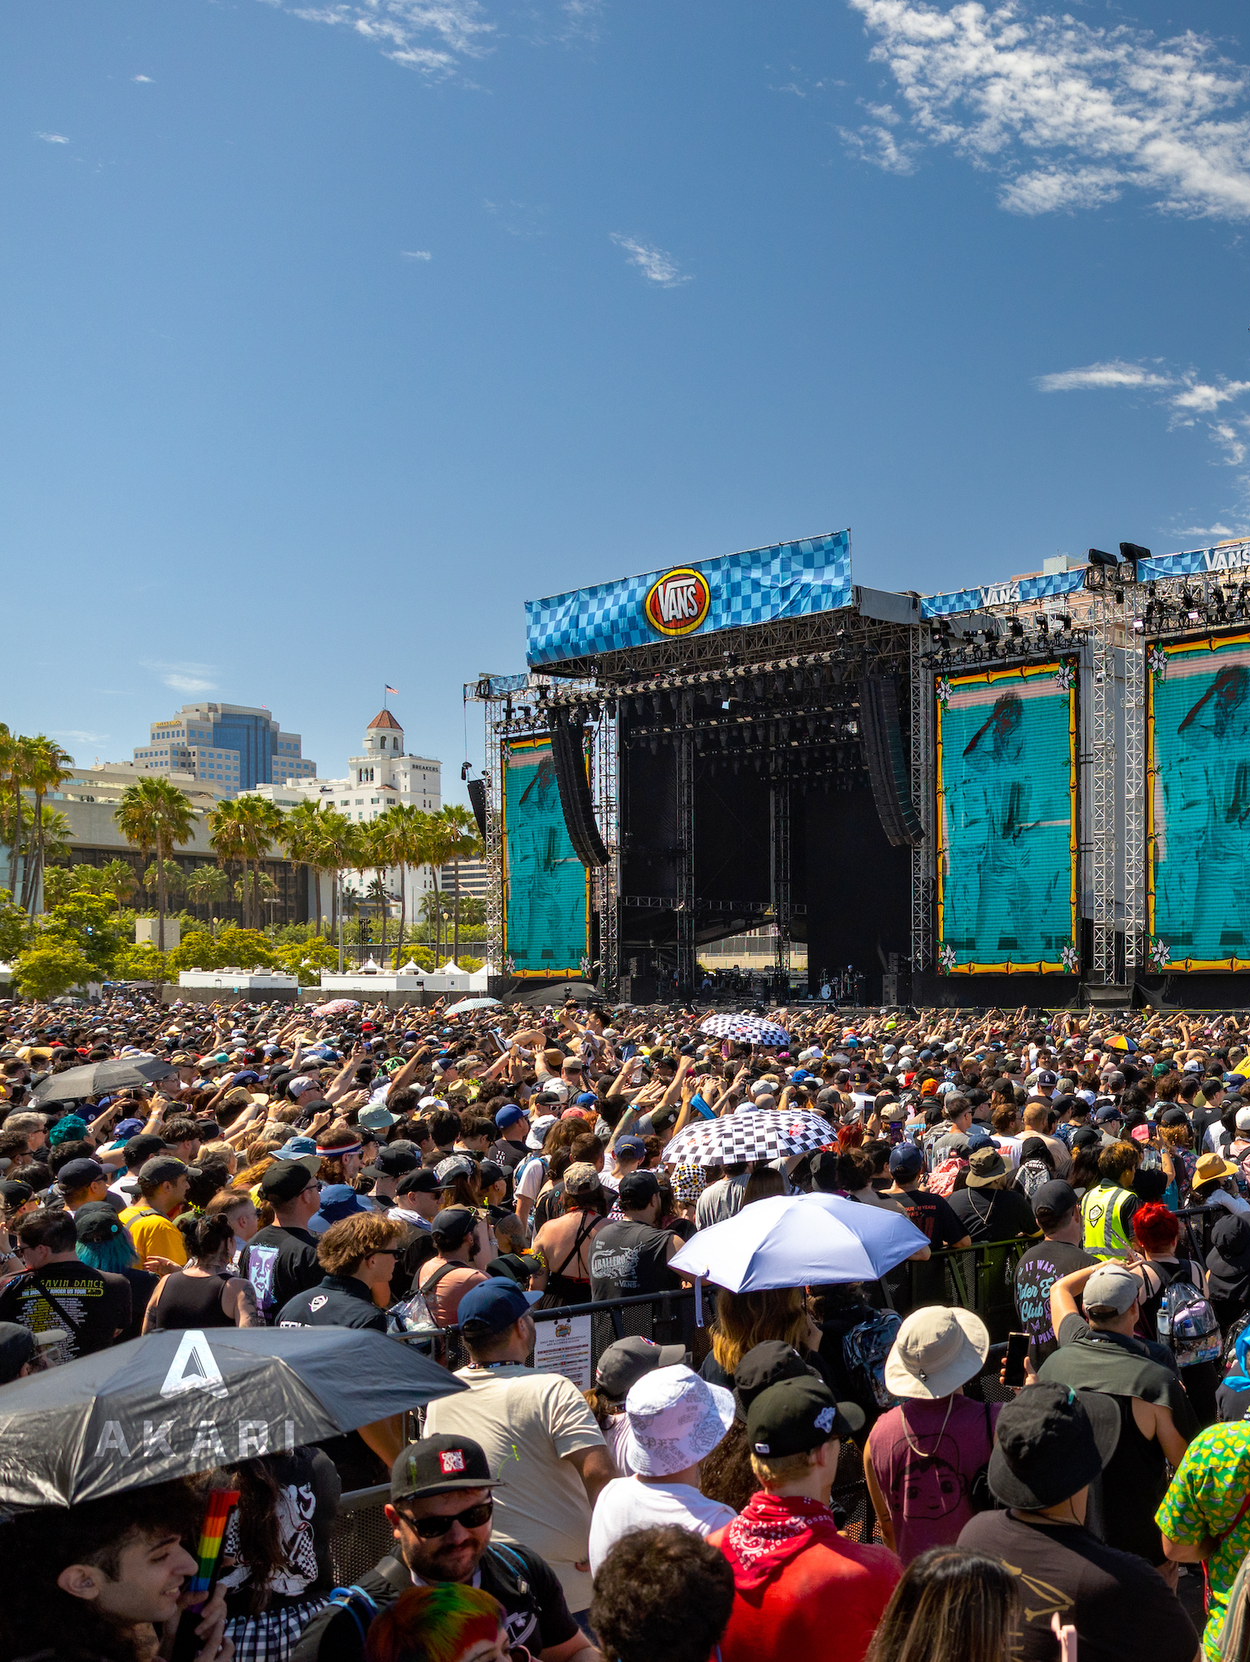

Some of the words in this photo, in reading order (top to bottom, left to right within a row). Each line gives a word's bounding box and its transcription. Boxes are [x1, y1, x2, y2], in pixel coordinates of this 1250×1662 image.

[657, 577, 699, 623] VANS
[980, 581, 1020, 607] VANS
[411, 763, 439, 773] BREAKERS
[1025, 1260, 1034, 1272] IT
[1036, 1259, 1055, 1274] WAS
[73, 1279, 104, 1288] DANCE
[619, 1279, 638, 1288] VANS
[1021, 1300, 1044, 1323] Club
[1038, 1327, 1055, 1345] PHAS
